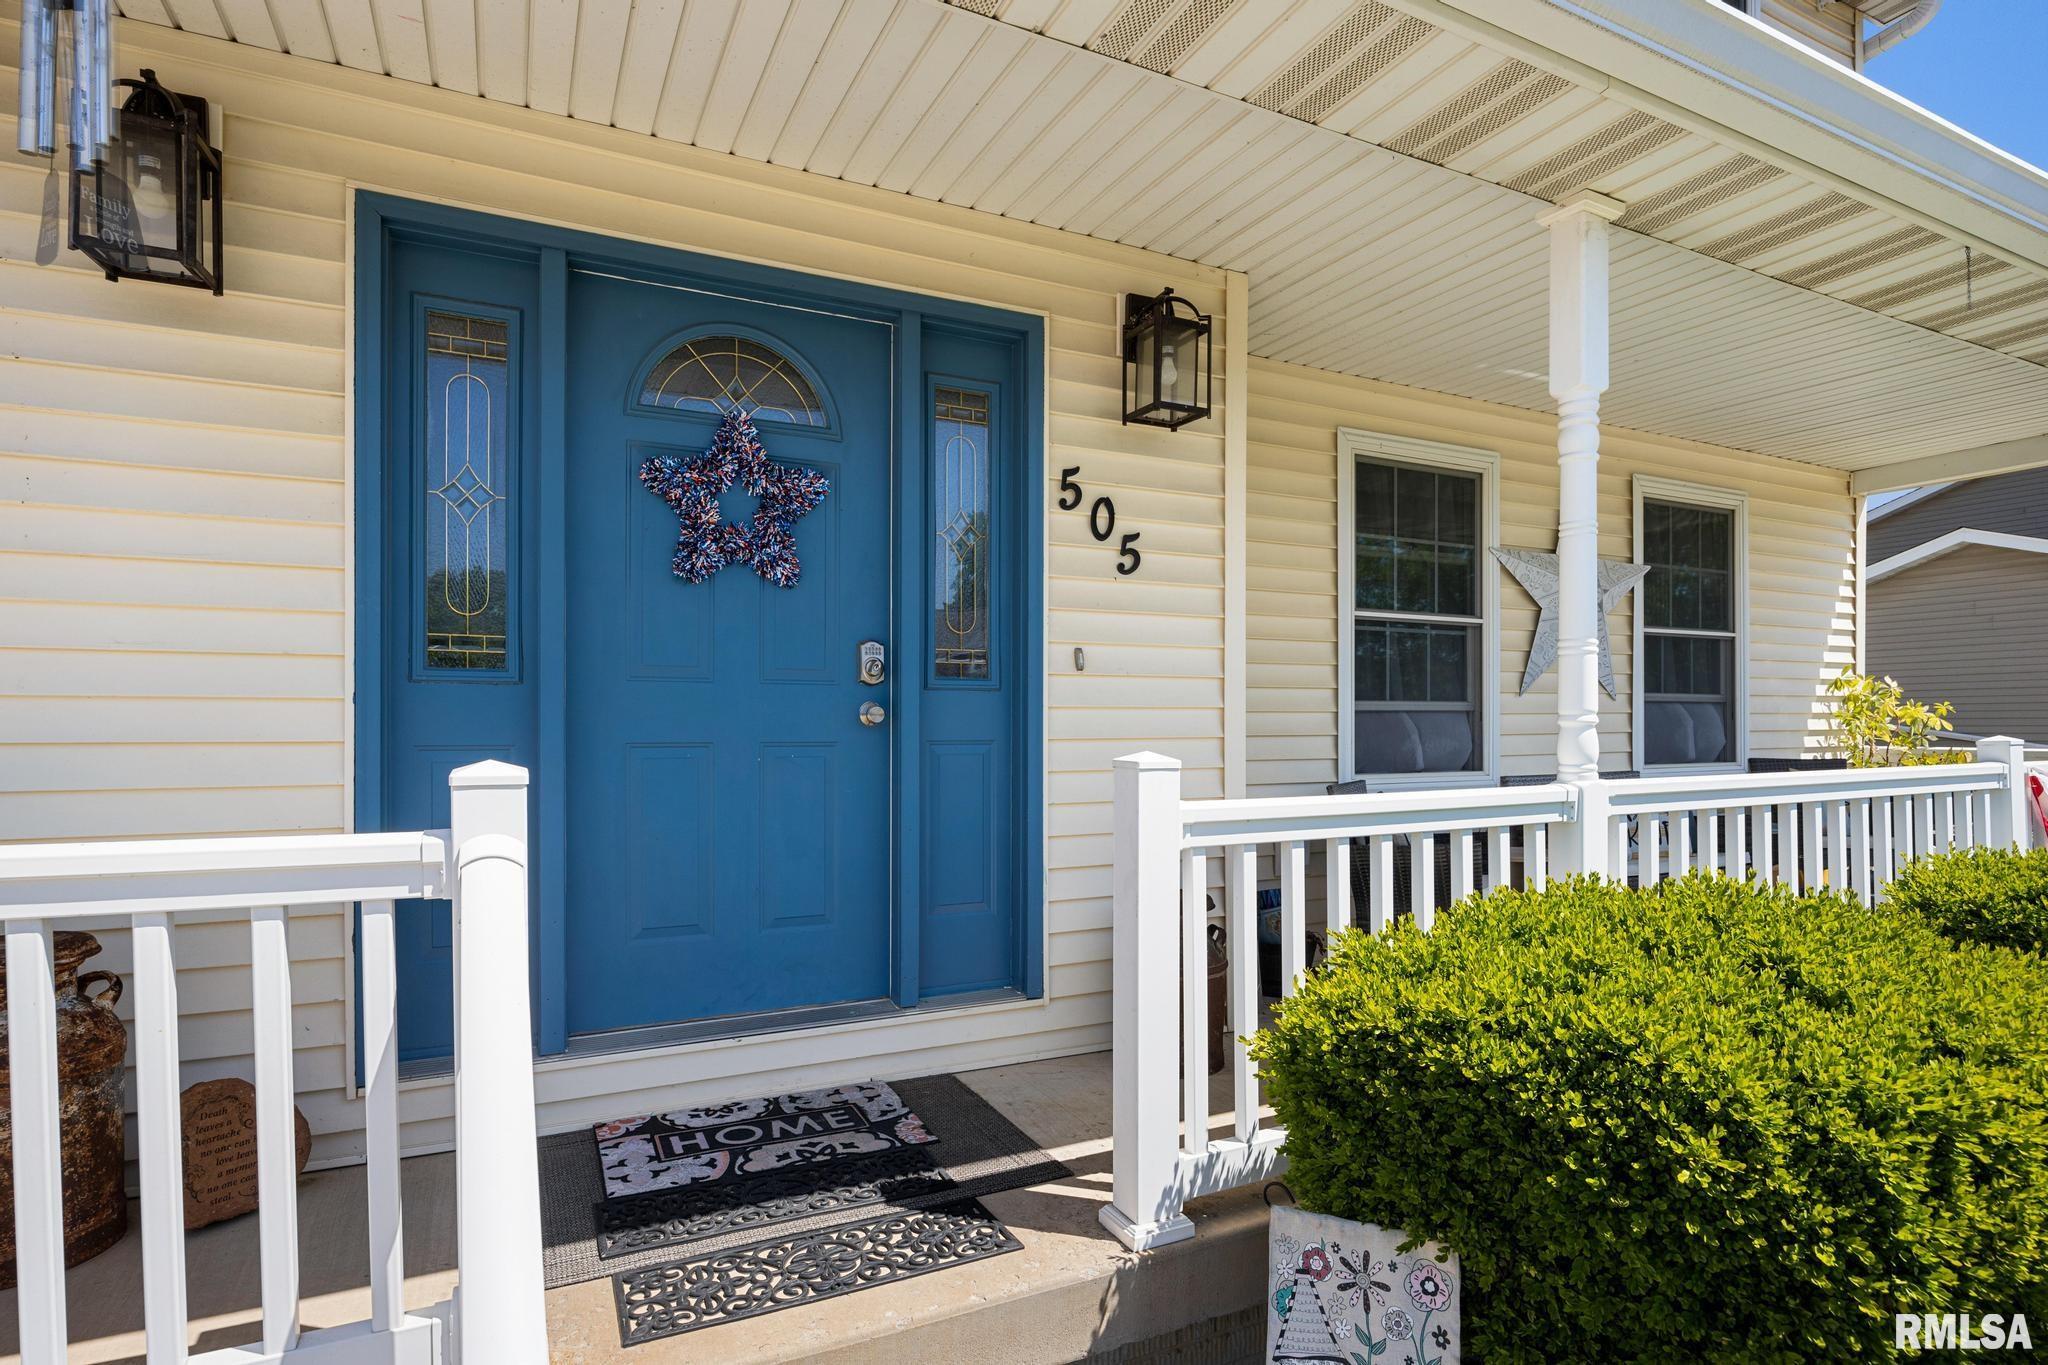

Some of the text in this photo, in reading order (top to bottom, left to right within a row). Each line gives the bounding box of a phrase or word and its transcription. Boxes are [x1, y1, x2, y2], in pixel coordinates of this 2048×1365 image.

[81, 185, 130, 220] Family
[83, 214, 139, 254] Love
[1058, 466, 1141, 575] 505
[200, 1107, 229, 1121] Death
[195, 1119, 233, 1135] leaves a
[669, 1109, 856, 1155] HOME
[195, 1128, 241, 1148] heartache
[200, 1139, 251, 1159] no one can
[215, 1155, 234, 1167] love
[217, 1161, 257, 1179] a memor
[207, 1185, 219, 1194] no
[221, 1180, 238, 1191] one
